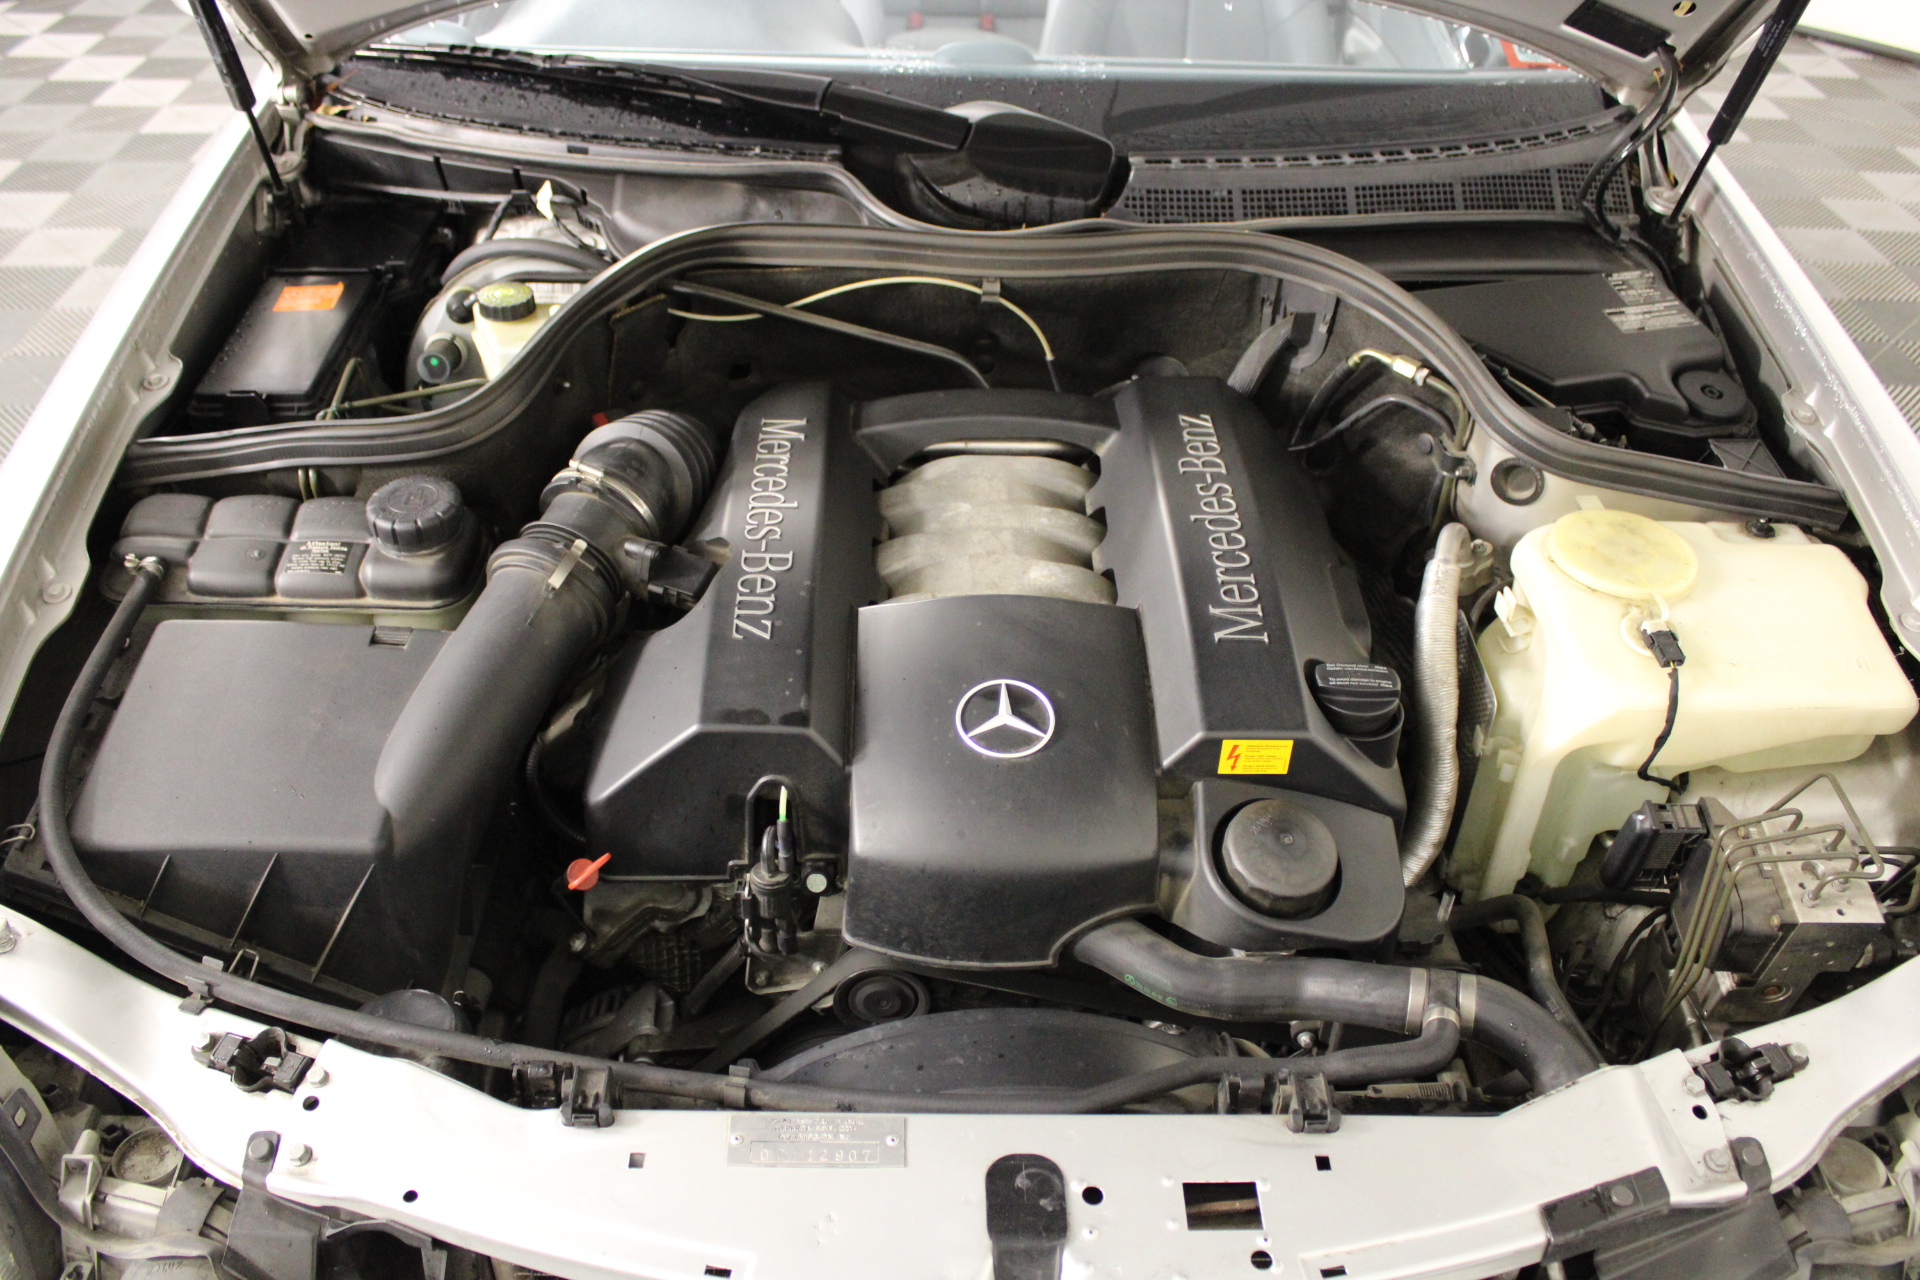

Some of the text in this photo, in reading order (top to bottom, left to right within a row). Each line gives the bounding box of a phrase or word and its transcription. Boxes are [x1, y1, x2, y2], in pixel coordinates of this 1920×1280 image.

[732, 417, 808, 641] Mercedes-Benz
[1178, 413, 1270, 645] Mercedes-Benz
[806, 1149, 871, 1162] 12907
